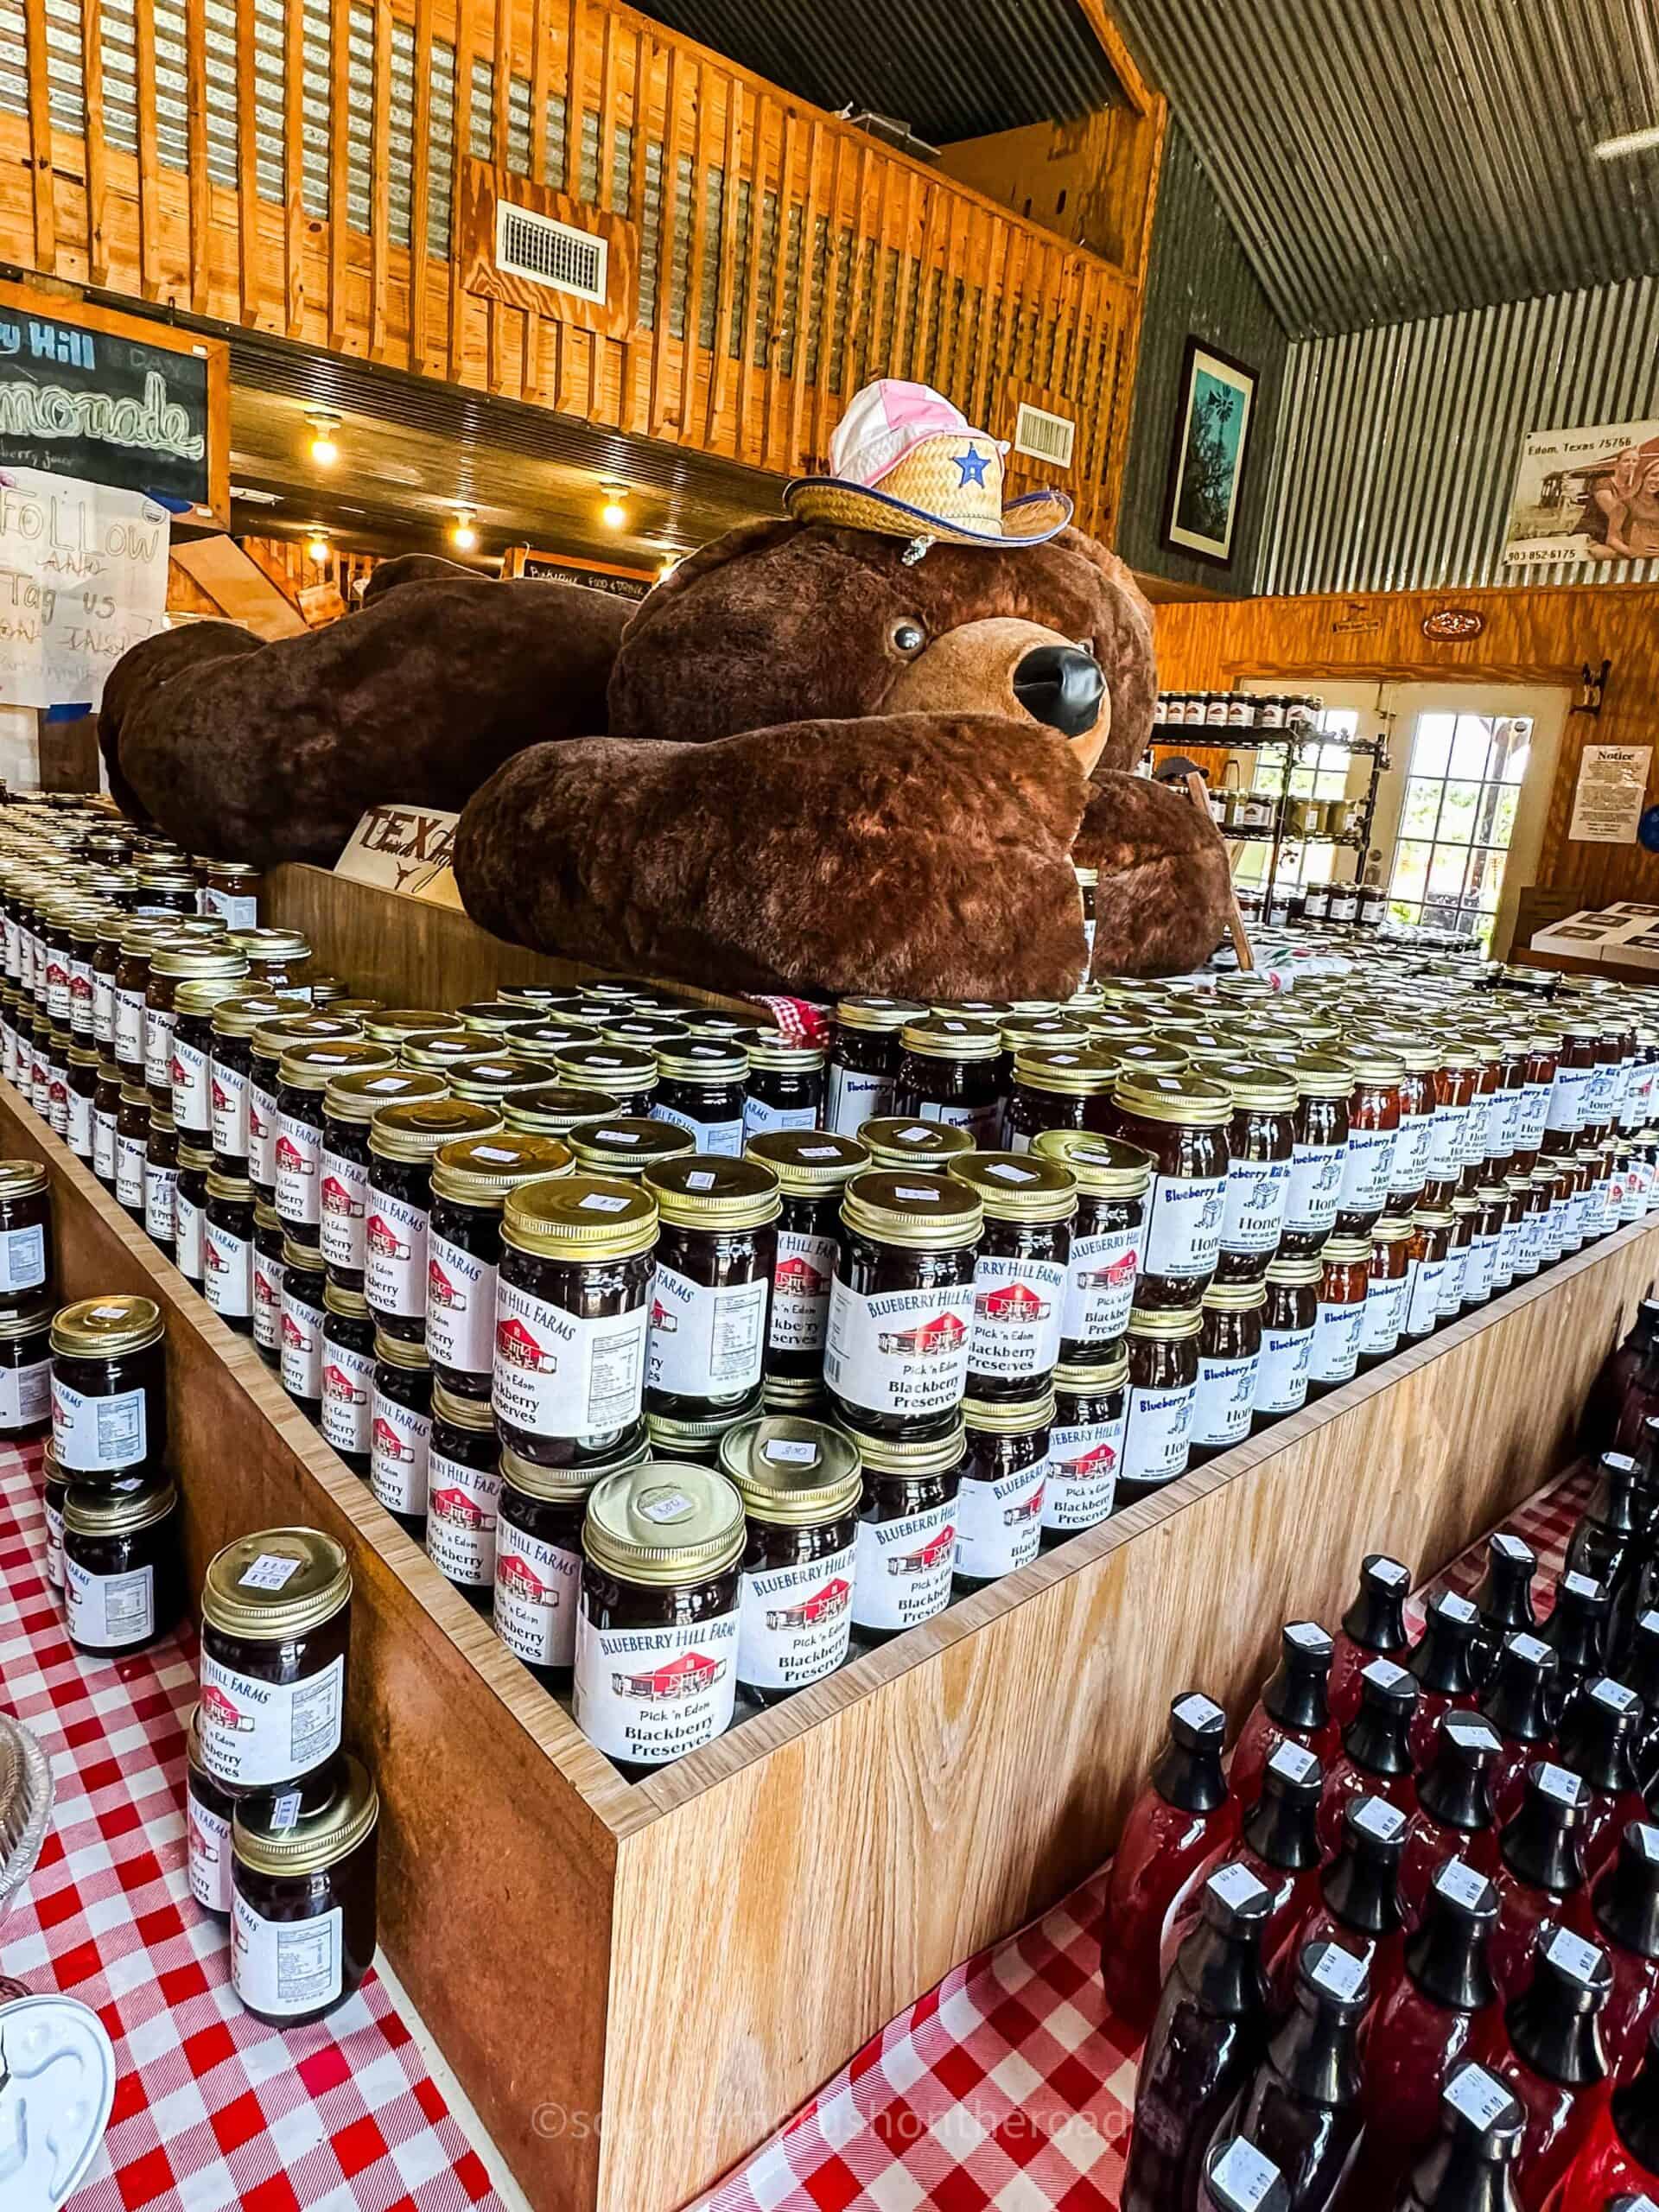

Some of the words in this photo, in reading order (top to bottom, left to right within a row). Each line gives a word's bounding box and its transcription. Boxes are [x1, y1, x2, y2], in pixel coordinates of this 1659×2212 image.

[29, 321, 96, 371] Hill
[1563, 442, 1595, 452] Texas
[1598, 751, 1635, 760] Notice
[1166, 1186, 1215, 1204] Blueberry
[389, 1202, 426, 1233] FARMS
[788, 1235, 812, 1254] HILL
[446, 1248, 483, 1283] FARMS
[1007, 1262, 1034, 1278] HILL
[657, 1269, 696, 1304] FARMS
[867, 1293, 936, 1319] BLUEBERRY
[937, 1290, 961, 1306] HILL
[506, 1292, 531, 1321] HILL
[531, 1305, 577, 1342] FARMS
[974, 1325, 997, 1338] Pick
[1010, 1329, 1035, 1341] Edom
[1269, 1336, 1309, 1352] Blueberry
[902, 1363, 928, 1376] Pick
[939, 1361, 959, 1374] Edom
[966, 1354, 1035, 1371] Preserves
[512, 1372, 536, 1393] Edom
[1204, 1365, 1249, 1382] Blueberry
[887, 1374, 960, 1395] Blackberry
[893, 1389, 958, 1409] Preserves
[1140, 1395, 1187, 1414] Blueberry
[394, 1409, 429, 1437] FARMS
[447, 1464, 470, 1486] HILL
[1065, 1487, 1085, 1497] Pick
[874, 1510, 940, 1546] BLUEBERRY
[454, 1535, 479, 1550] Edom
[508, 1527, 531, 1556] HILL
[533, 1545, 577, 1579] FARMS
[751, 1567, 823, 1599] BLUEBERRY
[824, 1554, 848, 1578] HILL
[911, 1579, 931, 1594] Pick
[516, 1606, 539, 1626] Edom
[599, 1631, 673, 1656] BLUEBERRY
[677, 1627, 706, 1649] HILL
[792, 1634, 817, 1650] Pick
[207, 1666, 230, 1690] HILL
[230, 1673, 271, 1705] FARMS
[639, 1707, 669, 1723] Pick
[683, 1700, 711, 1719] Edom
[624, 1714, 715, 1742] Blackberry
[214, 1732, 237, 1749] Edom
[630, 1730, 713, 1758] Preserves
